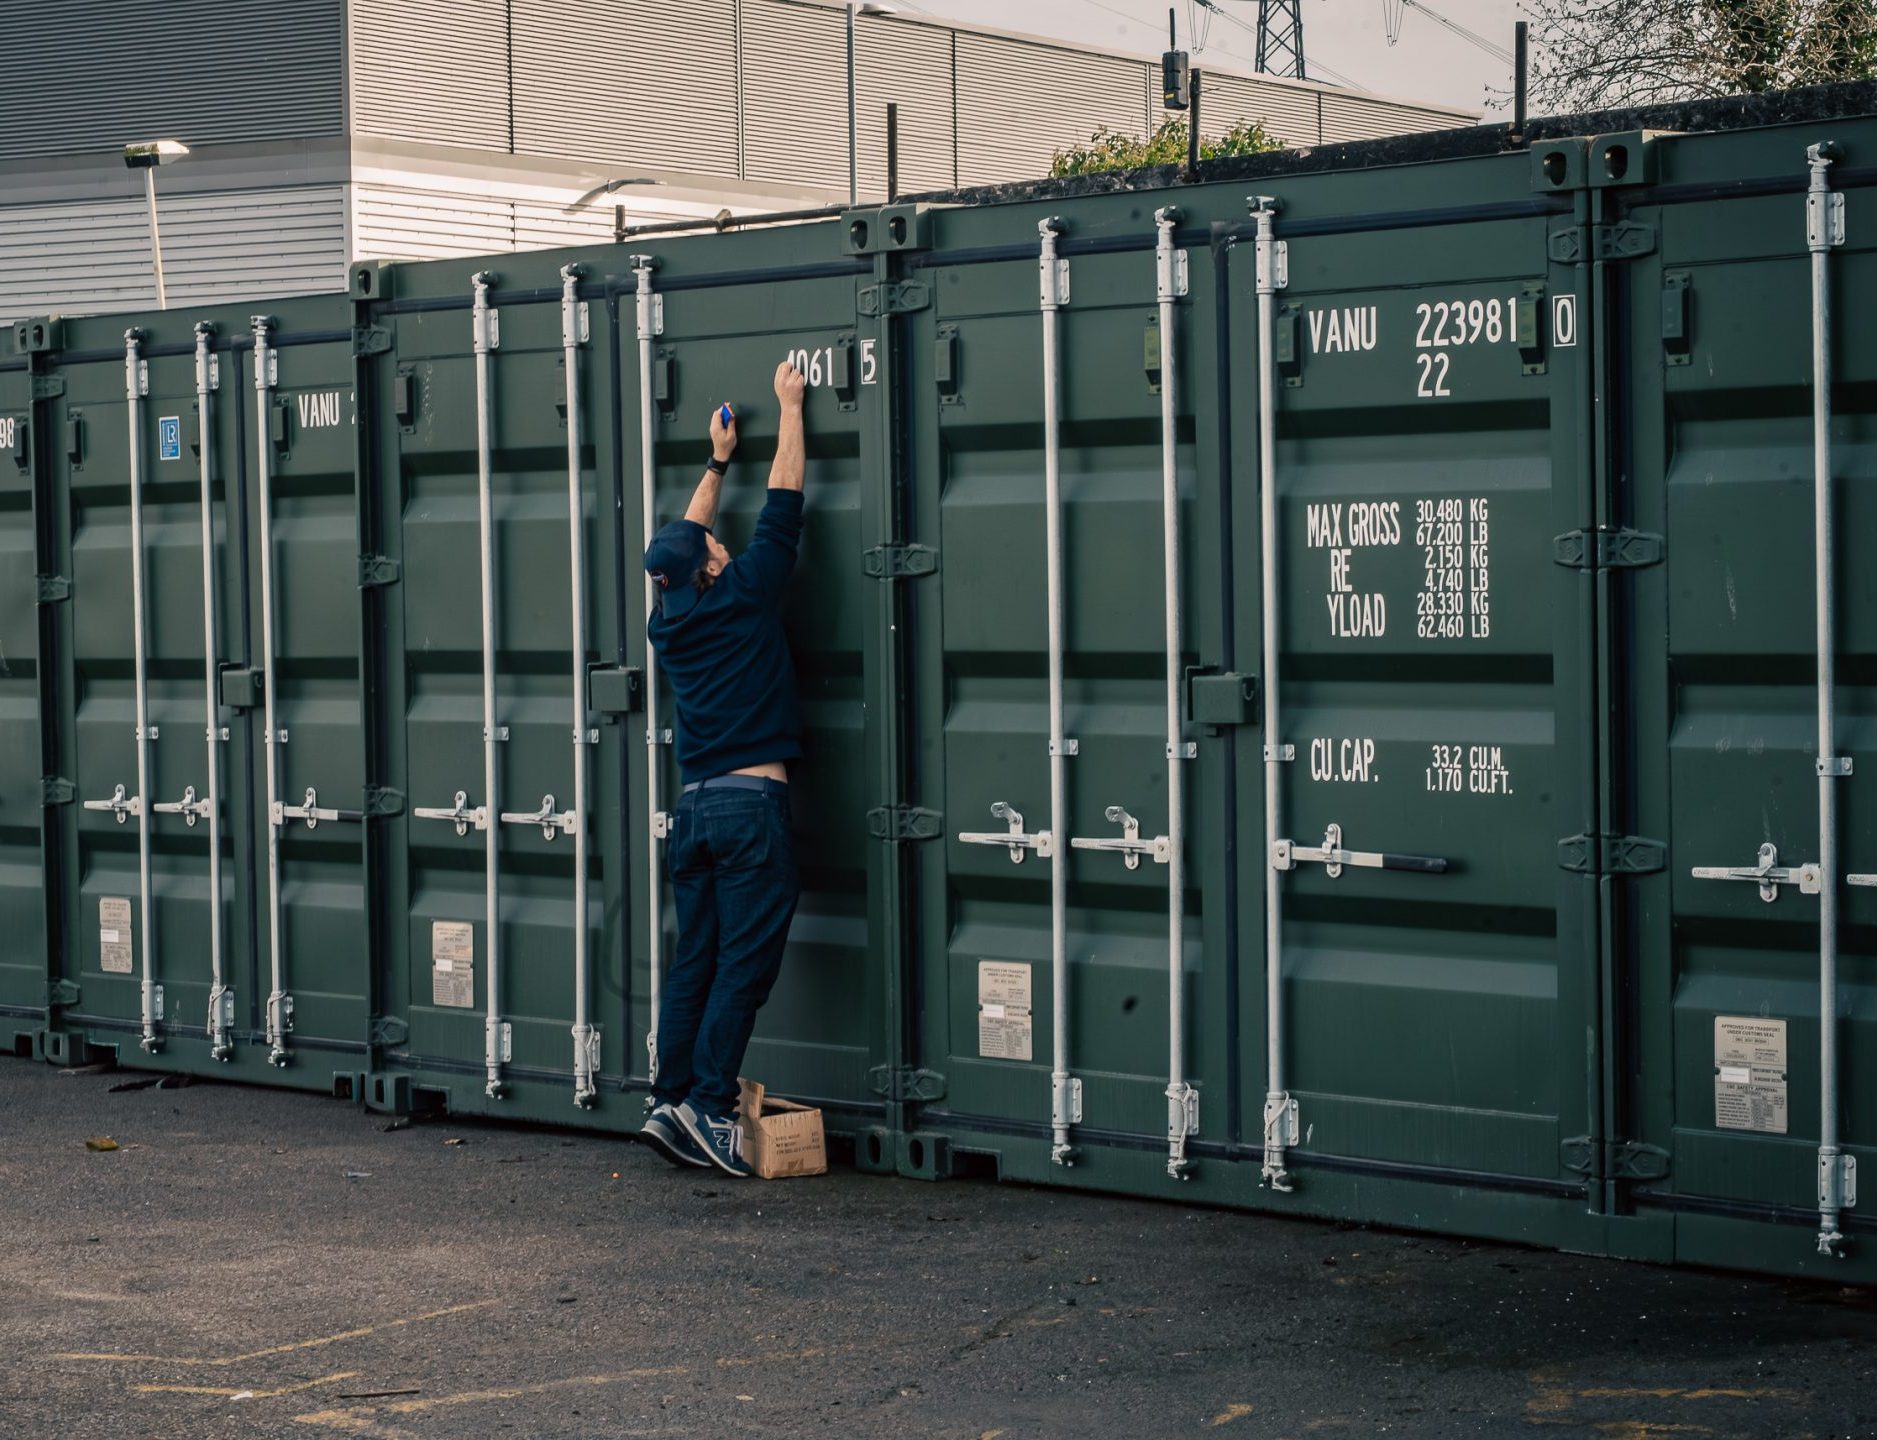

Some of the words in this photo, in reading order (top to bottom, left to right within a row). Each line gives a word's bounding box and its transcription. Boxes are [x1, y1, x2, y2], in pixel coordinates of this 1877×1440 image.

[1308, 306, 1377, 354] VANU
[1415, 296, 1517, 348] 223981
[1554, 296, 1575, 346] 0
[861, 341, 877, 383] 5
[1416, 351, 1451, 398] 22
[298, 391, 340, 429] VANU
[1306, 503, 1343, 548] MAX
[1348, 501, 1401, 547] GROSS
[1415, 498, 1463, 524] 30,480
[1469, 497, 1489, 522] KG
[1415, 521, 1463, 547] 67,200
[1470, 521, 1489, 545] LB
[1330, 548, 1353, 593] RE
[1424, 545, 1463, 569] 2,150
[1470, 544, 1489, 569] KG
[1424, 568, 1464, 592] 4,740
[1470, 567, 1489, 592] LB
[1326, 593, 1386, 638] YLOAD
[1416, 591, 1464, 616] 28,330
[1470, 591, 1489, 615] KG
[1417, 614, 1464, 639] 62,460
[1471, 614, 1490, 638] LB
[1310, 737, 1379, 783] CU.CAP.
[1431, 744, 1463, 770] 33.2
[1425, 767, 1463, 792] 1,170
